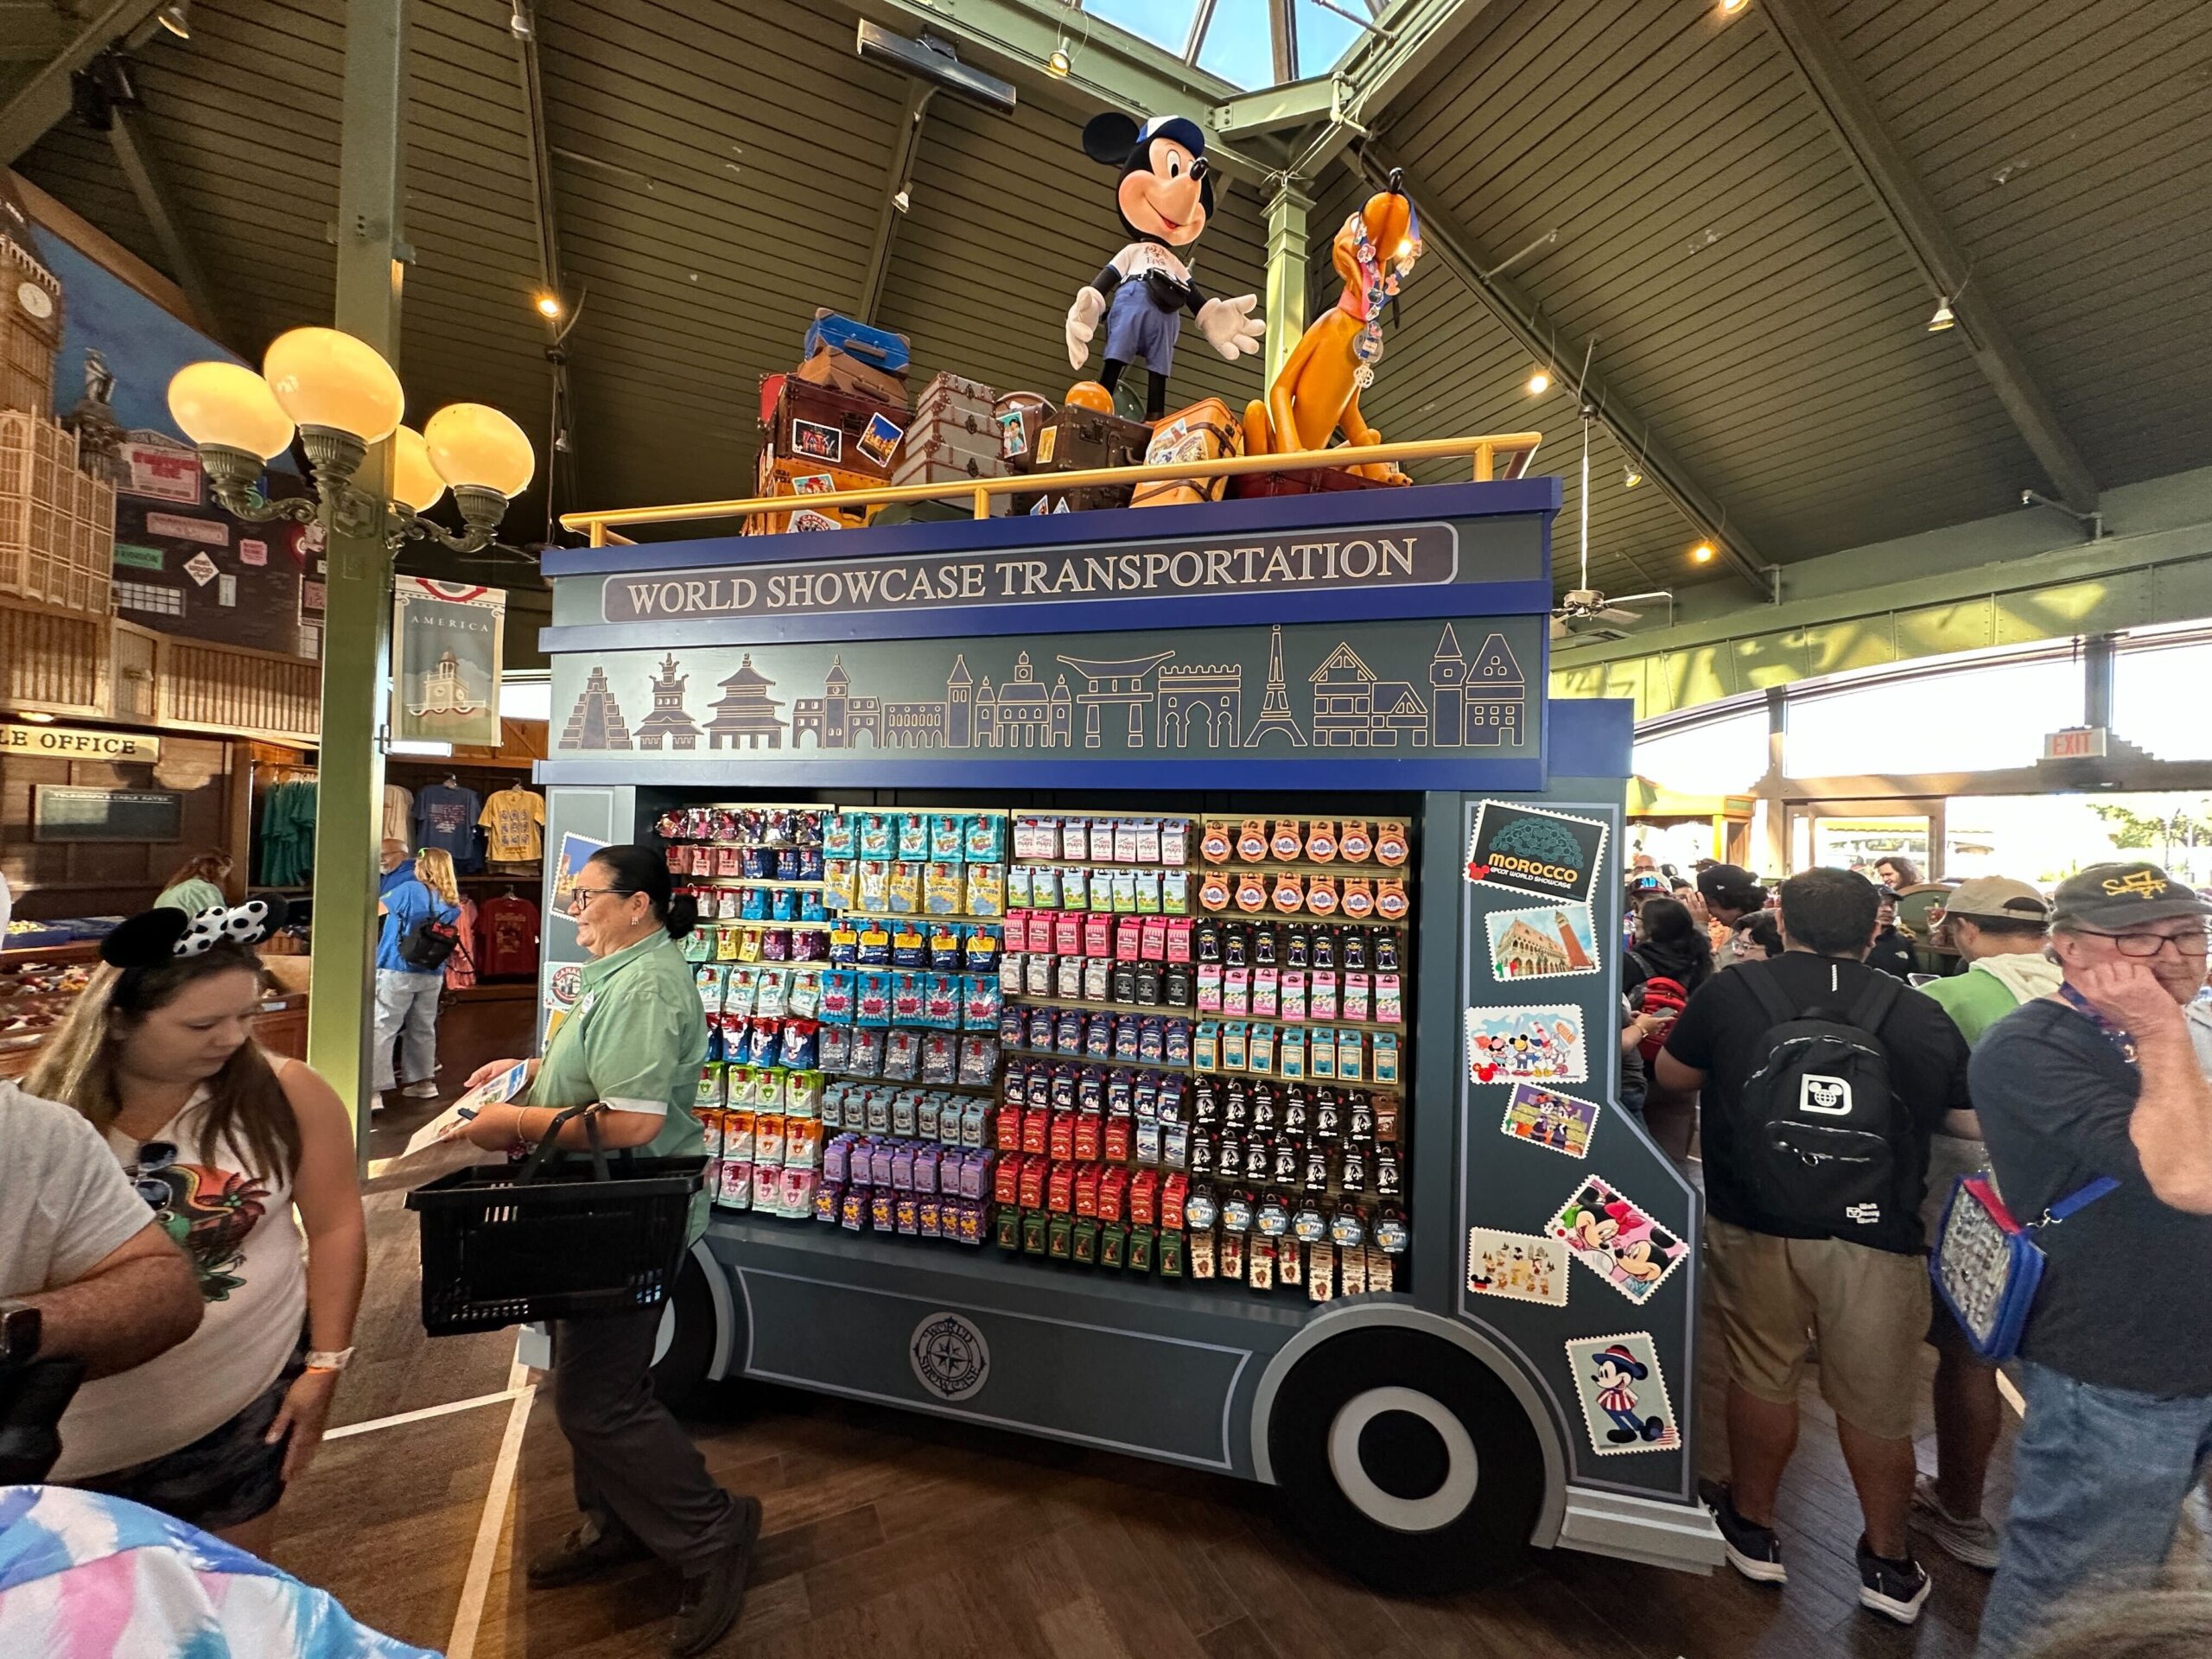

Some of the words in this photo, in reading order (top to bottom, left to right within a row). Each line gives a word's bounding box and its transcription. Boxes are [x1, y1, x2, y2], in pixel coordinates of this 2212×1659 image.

[627, 578, 757, 614] WORLD
[766, 564, 986, 608] SHOWCASE
[995, 537, 1418, 597] TRANSPORTATION
[410, 615, 489, 632] AMERICA
[40, 733, 137, 754] OFFICE
[2052, 732, 2092, 756] EXIT
[1488, 853, 1578, 882] MOROCCO
[1490, 867, 1510, 875] EPCOT
[1510, 871, 1534, 880] WORLD
[1534, 876, 1572, 889] SHOWCASE
[922, 1321, 973, 1343] WORLD
[919, 1356, 981, 1391] SHOWCASE
